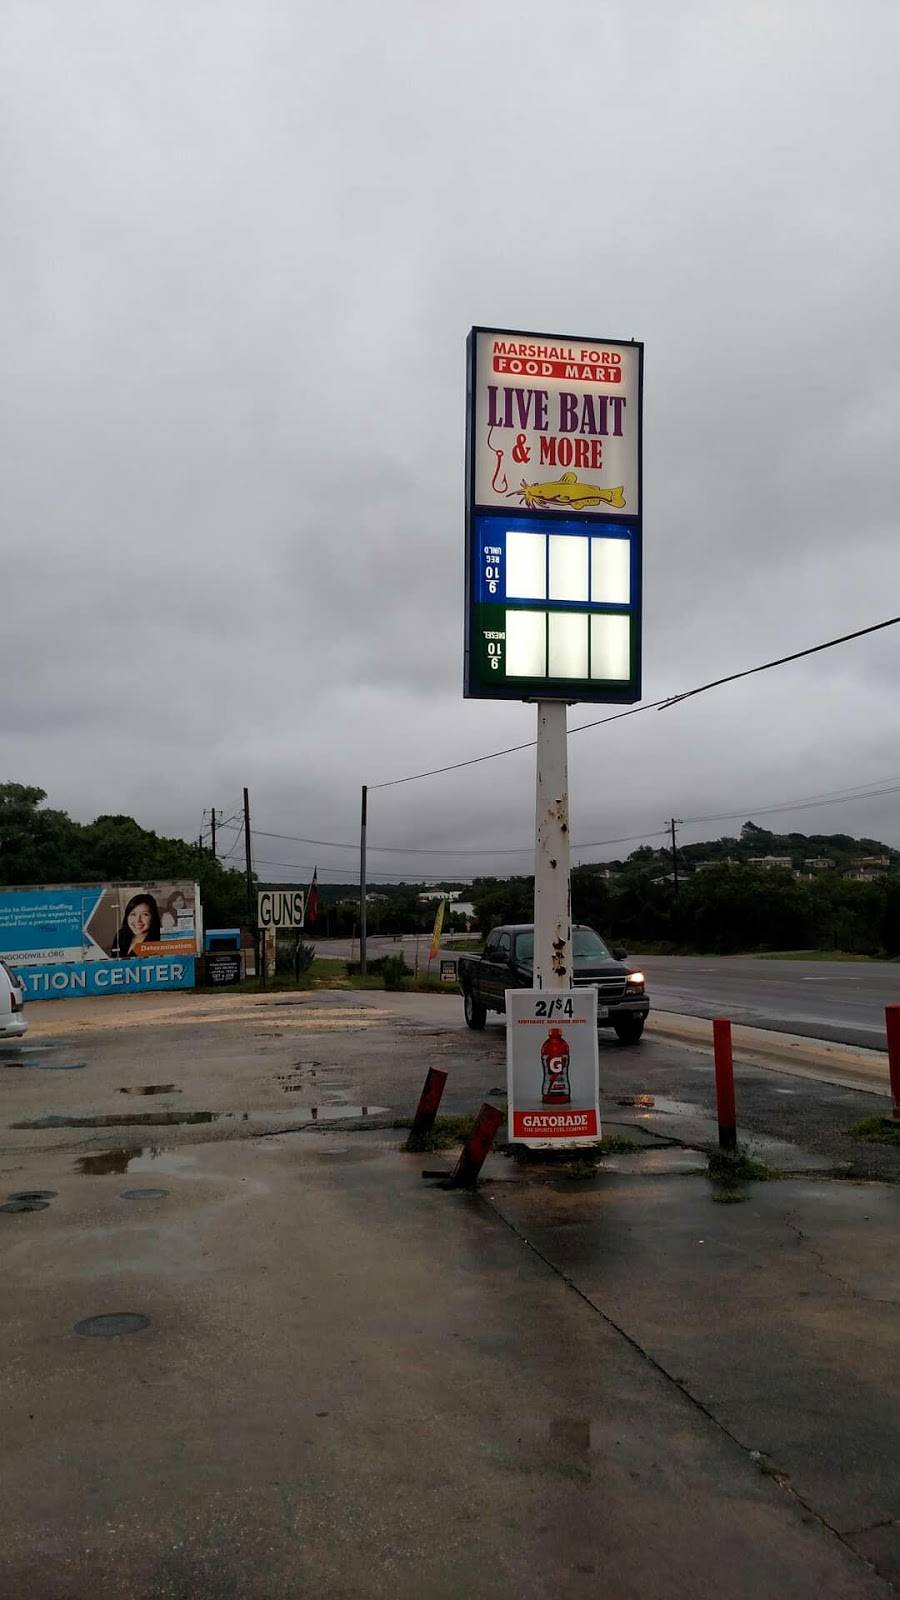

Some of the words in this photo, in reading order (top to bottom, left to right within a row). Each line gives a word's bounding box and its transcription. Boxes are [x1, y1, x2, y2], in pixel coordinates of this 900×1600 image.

[493, 341, 575, 361] MARSHALL
[580, 350, 622, 365] FORD
[498, 358, 553, 375] FOOD
[565, 364, 617, 381] MART
[487, 385, 549, 431] LIVE
[559, 392, 626, 436] BAIT
[512, 433, 531, 464] &
[540, 436, 603, 469] MORE
[484, 546, 501, 555] UNLD
[486, 555, 500, 563] REG
[483, 631, 506, 640] DIESEL
[261, 893, 303, 925] GUNS
[94, 963, 185, 986] CENTER
[523, 1114, 588, 1127] GATORADE
